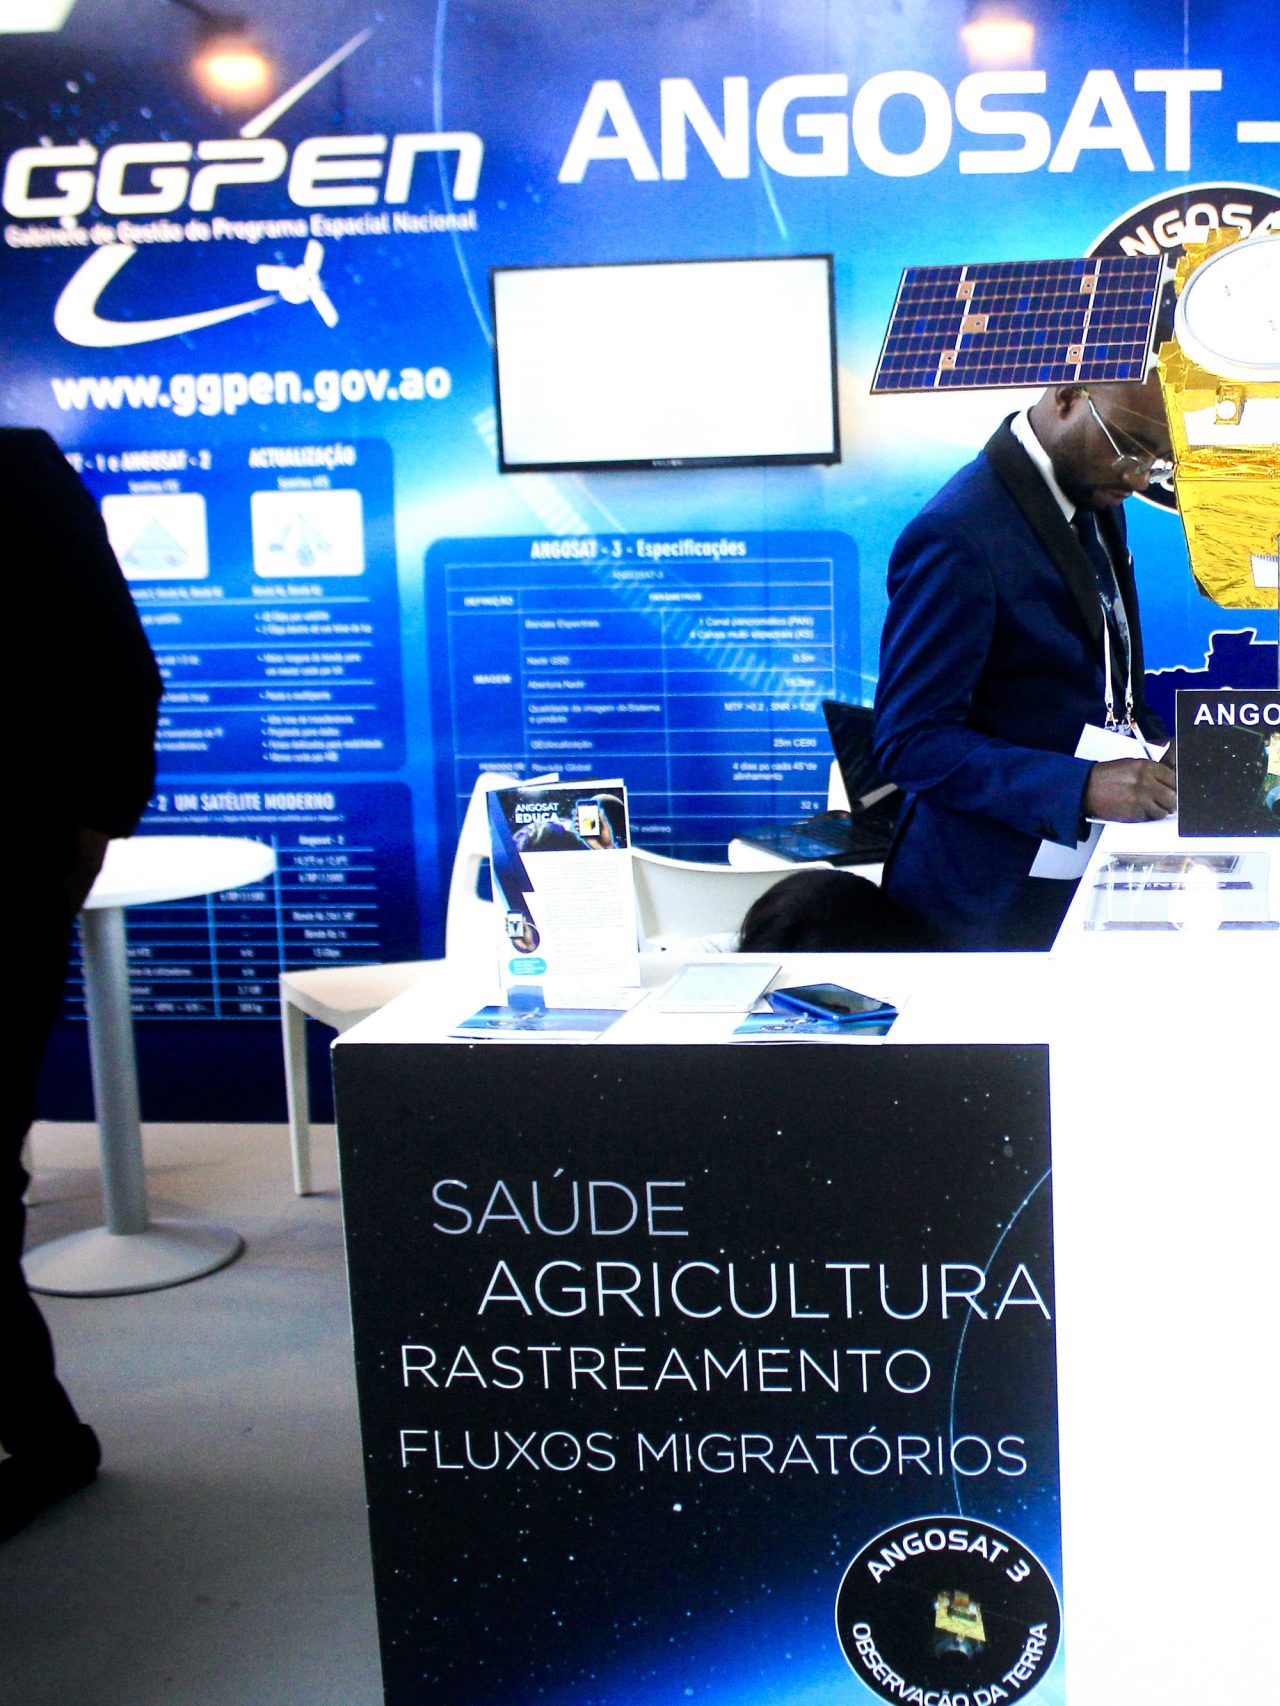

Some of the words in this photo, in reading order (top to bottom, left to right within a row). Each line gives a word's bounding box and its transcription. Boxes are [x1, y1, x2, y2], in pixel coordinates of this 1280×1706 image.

[558, 68, 1223, 183] ANGOSAT
[4, 225, 88, 248] Gabinete
[91, 222, 115, 245] de
[185, 220, 210, 241] do
[212, 217, 308, 244] Programa
[310, 212, 391, 240] Espacial
[393, 209, 478, 233] Nacional
[52, 363, 451, 416] www.ggpen.gov.ao
[530, 538, 598, 560] ANGOSAT
[611, 539, 623, 558] 3
[636, 537, 747, 561] Especificações
[200, 790, 261, 812] SATÉLITE
[264, 791, 336, 812] MODERNO
[515, 802, 560, 813] ANGOSAT
[515, 812, 560, 824] EDUCA
[431, 1167, 690, 1237] SAÚDE
[477, 1259, 1053, 1321] AGRICULTURA
[400, 1343, 932, 1395] RASTREAMENTO
[399, 1429, 617, 1474] FLUXOS
[637, 1425, 1028, 1478] MIGRATÓRIOS
[866, 1528, 1010, 1584] ANGOSAT
[1005, 1559, 1032, 1584] 3
[973, 1684, 1009, 1706] DA
[1001, 1622, 1049, 1689] TERRA
